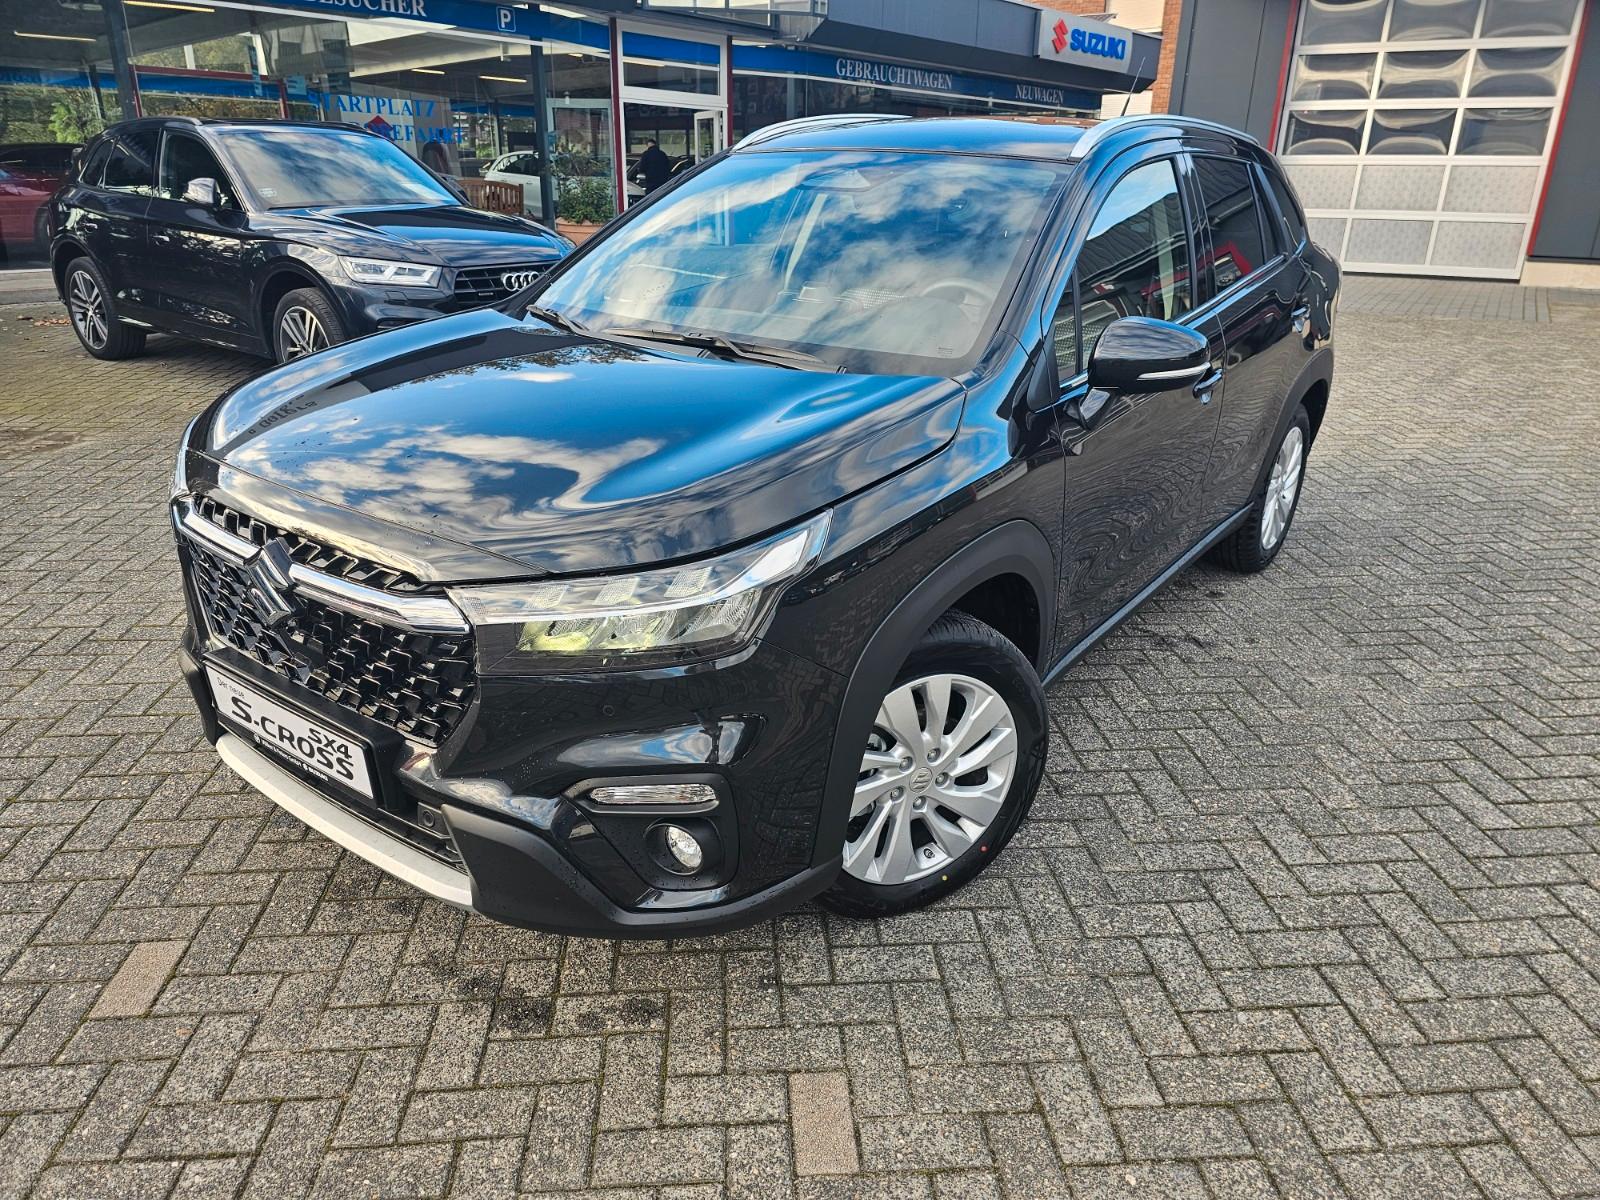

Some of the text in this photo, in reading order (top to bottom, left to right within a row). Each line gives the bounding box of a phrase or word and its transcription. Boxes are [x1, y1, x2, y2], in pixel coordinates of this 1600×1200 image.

[304, 0, 428, 17] UCHER
[1070, 28, 1126, 60] SUZUKI
[835, 58, 952, 89] GEBRAUCHTWAGEN
[1015, 84, 1064, 104] NEUWAGEN
[308, 727, 353, 760] SX4
